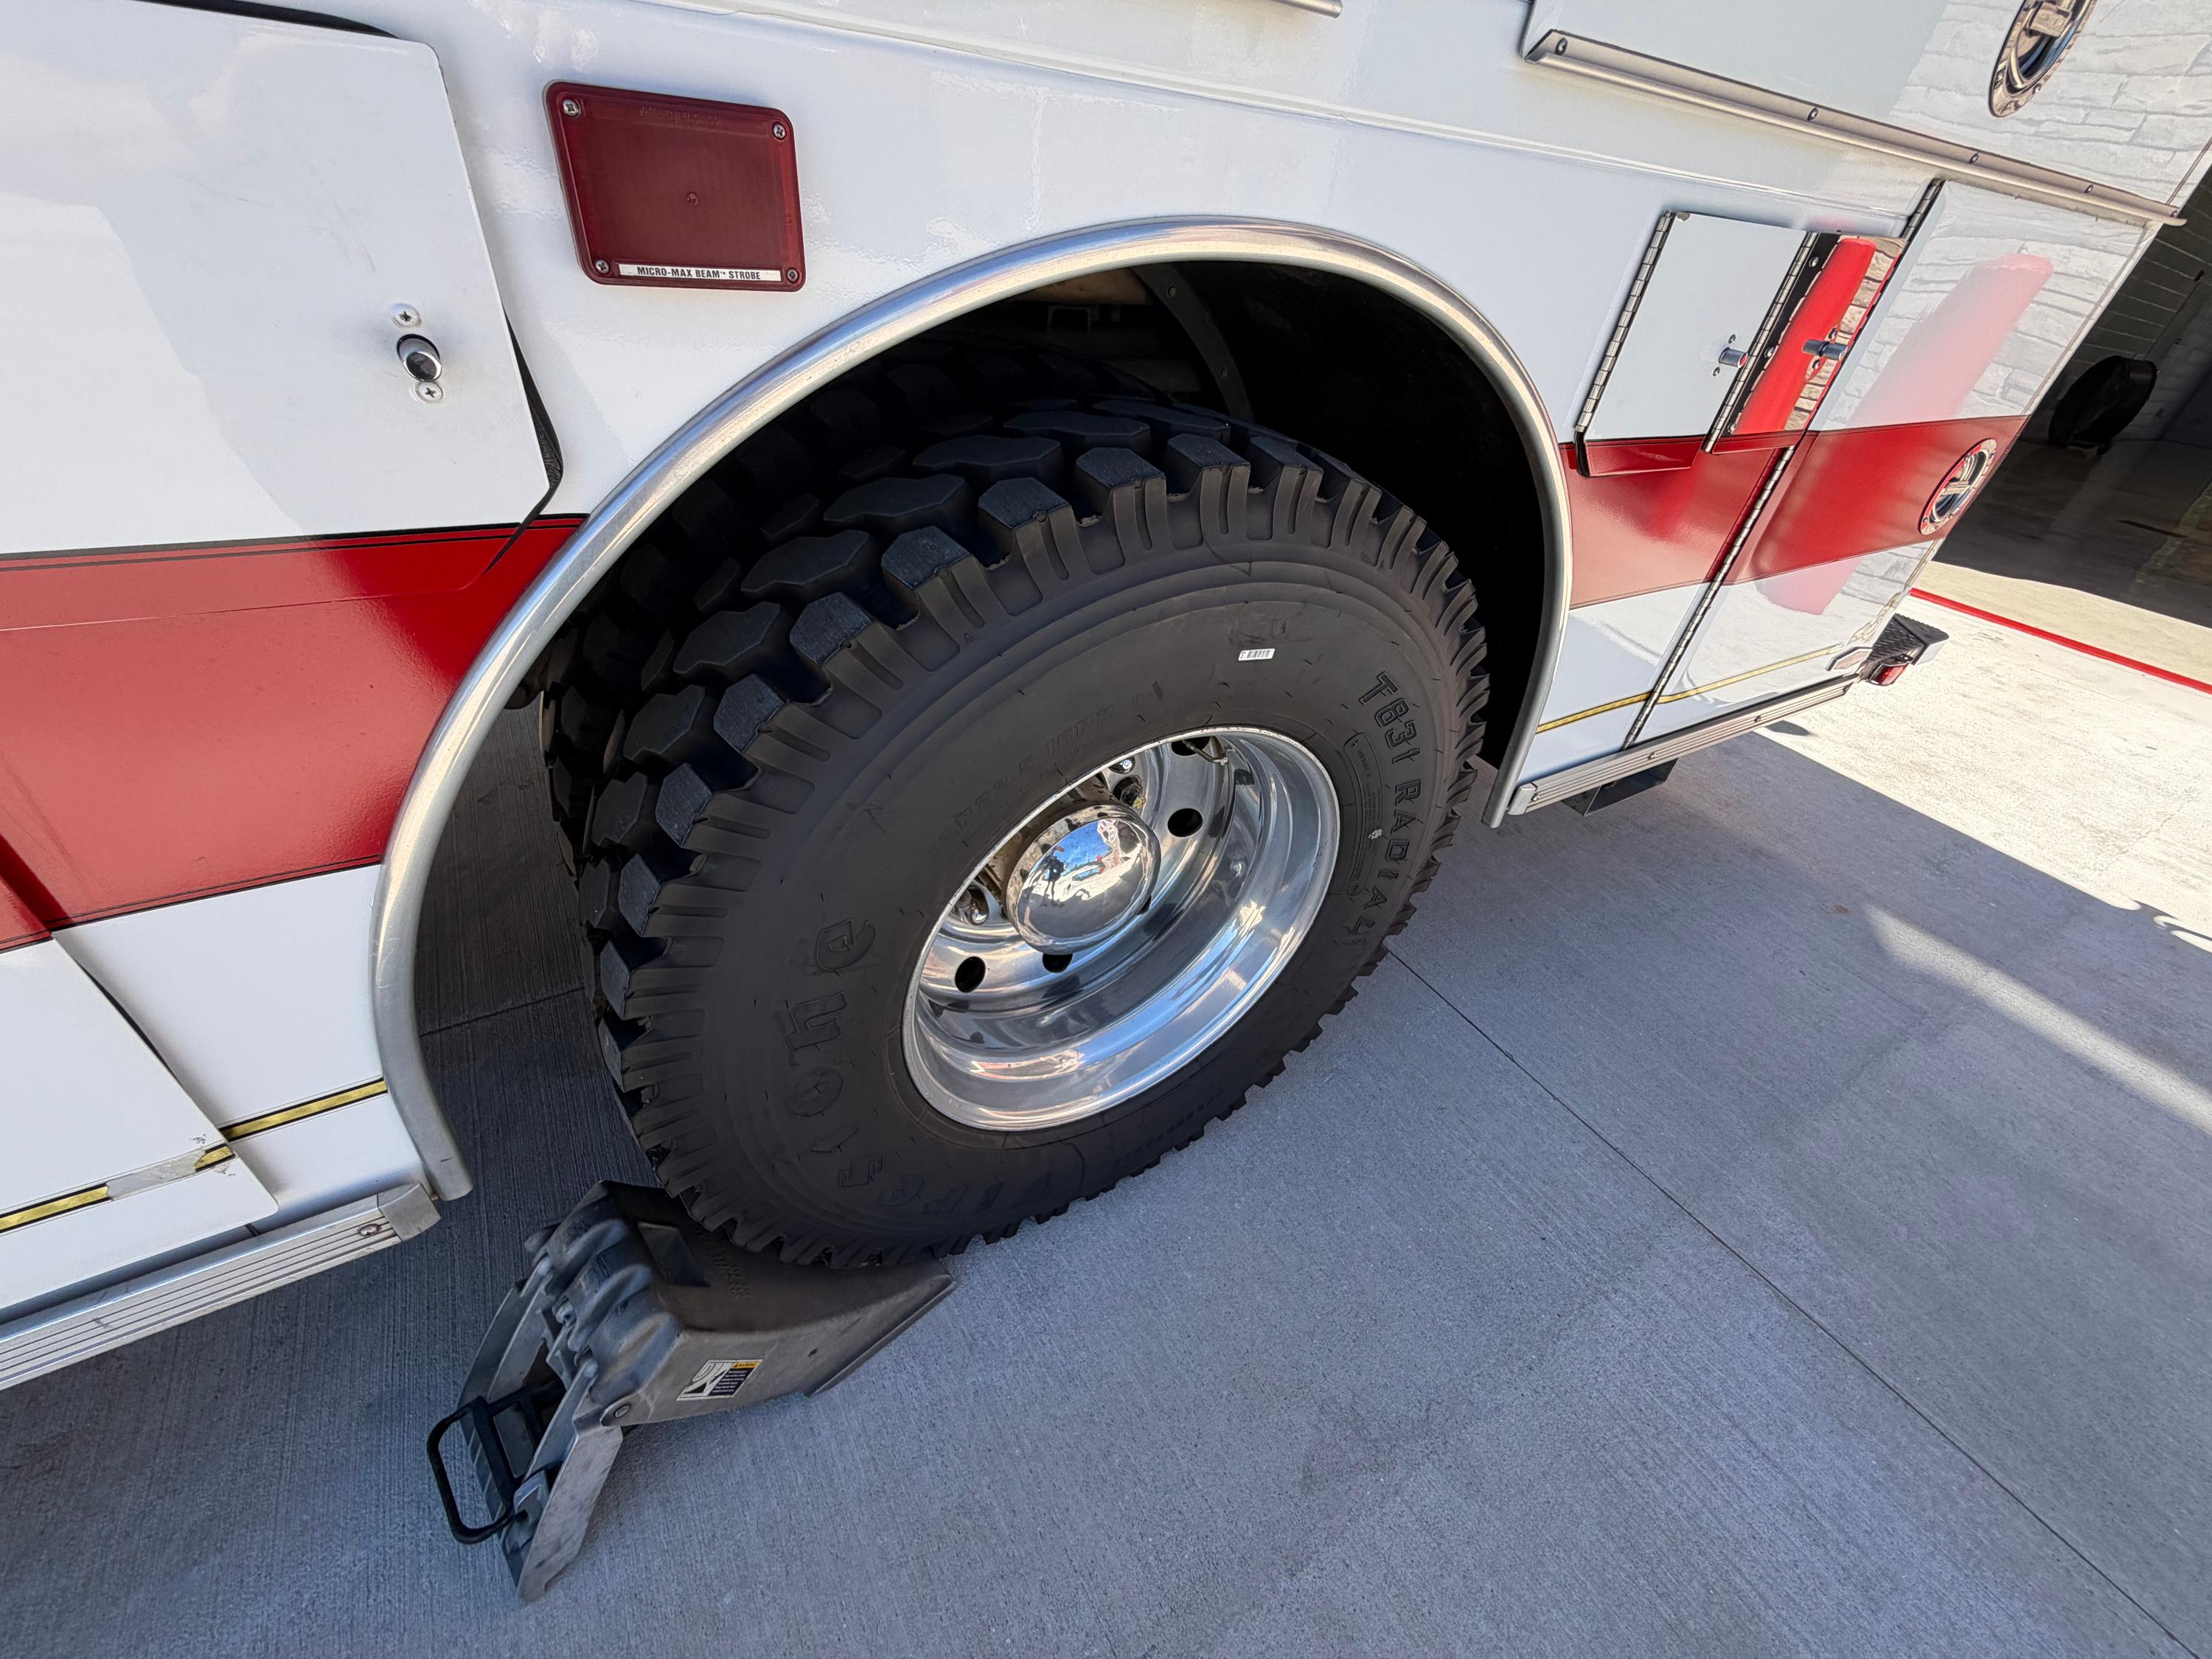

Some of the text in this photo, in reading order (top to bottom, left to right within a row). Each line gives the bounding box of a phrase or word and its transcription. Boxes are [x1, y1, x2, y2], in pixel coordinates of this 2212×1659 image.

[636, 266, 693, 277] MICRO-MAX
[728, 271, 761, 280] STROBE
[1358, 670, 1421, 765] T831
[1352, 778, 1422, 933] RADIAL
